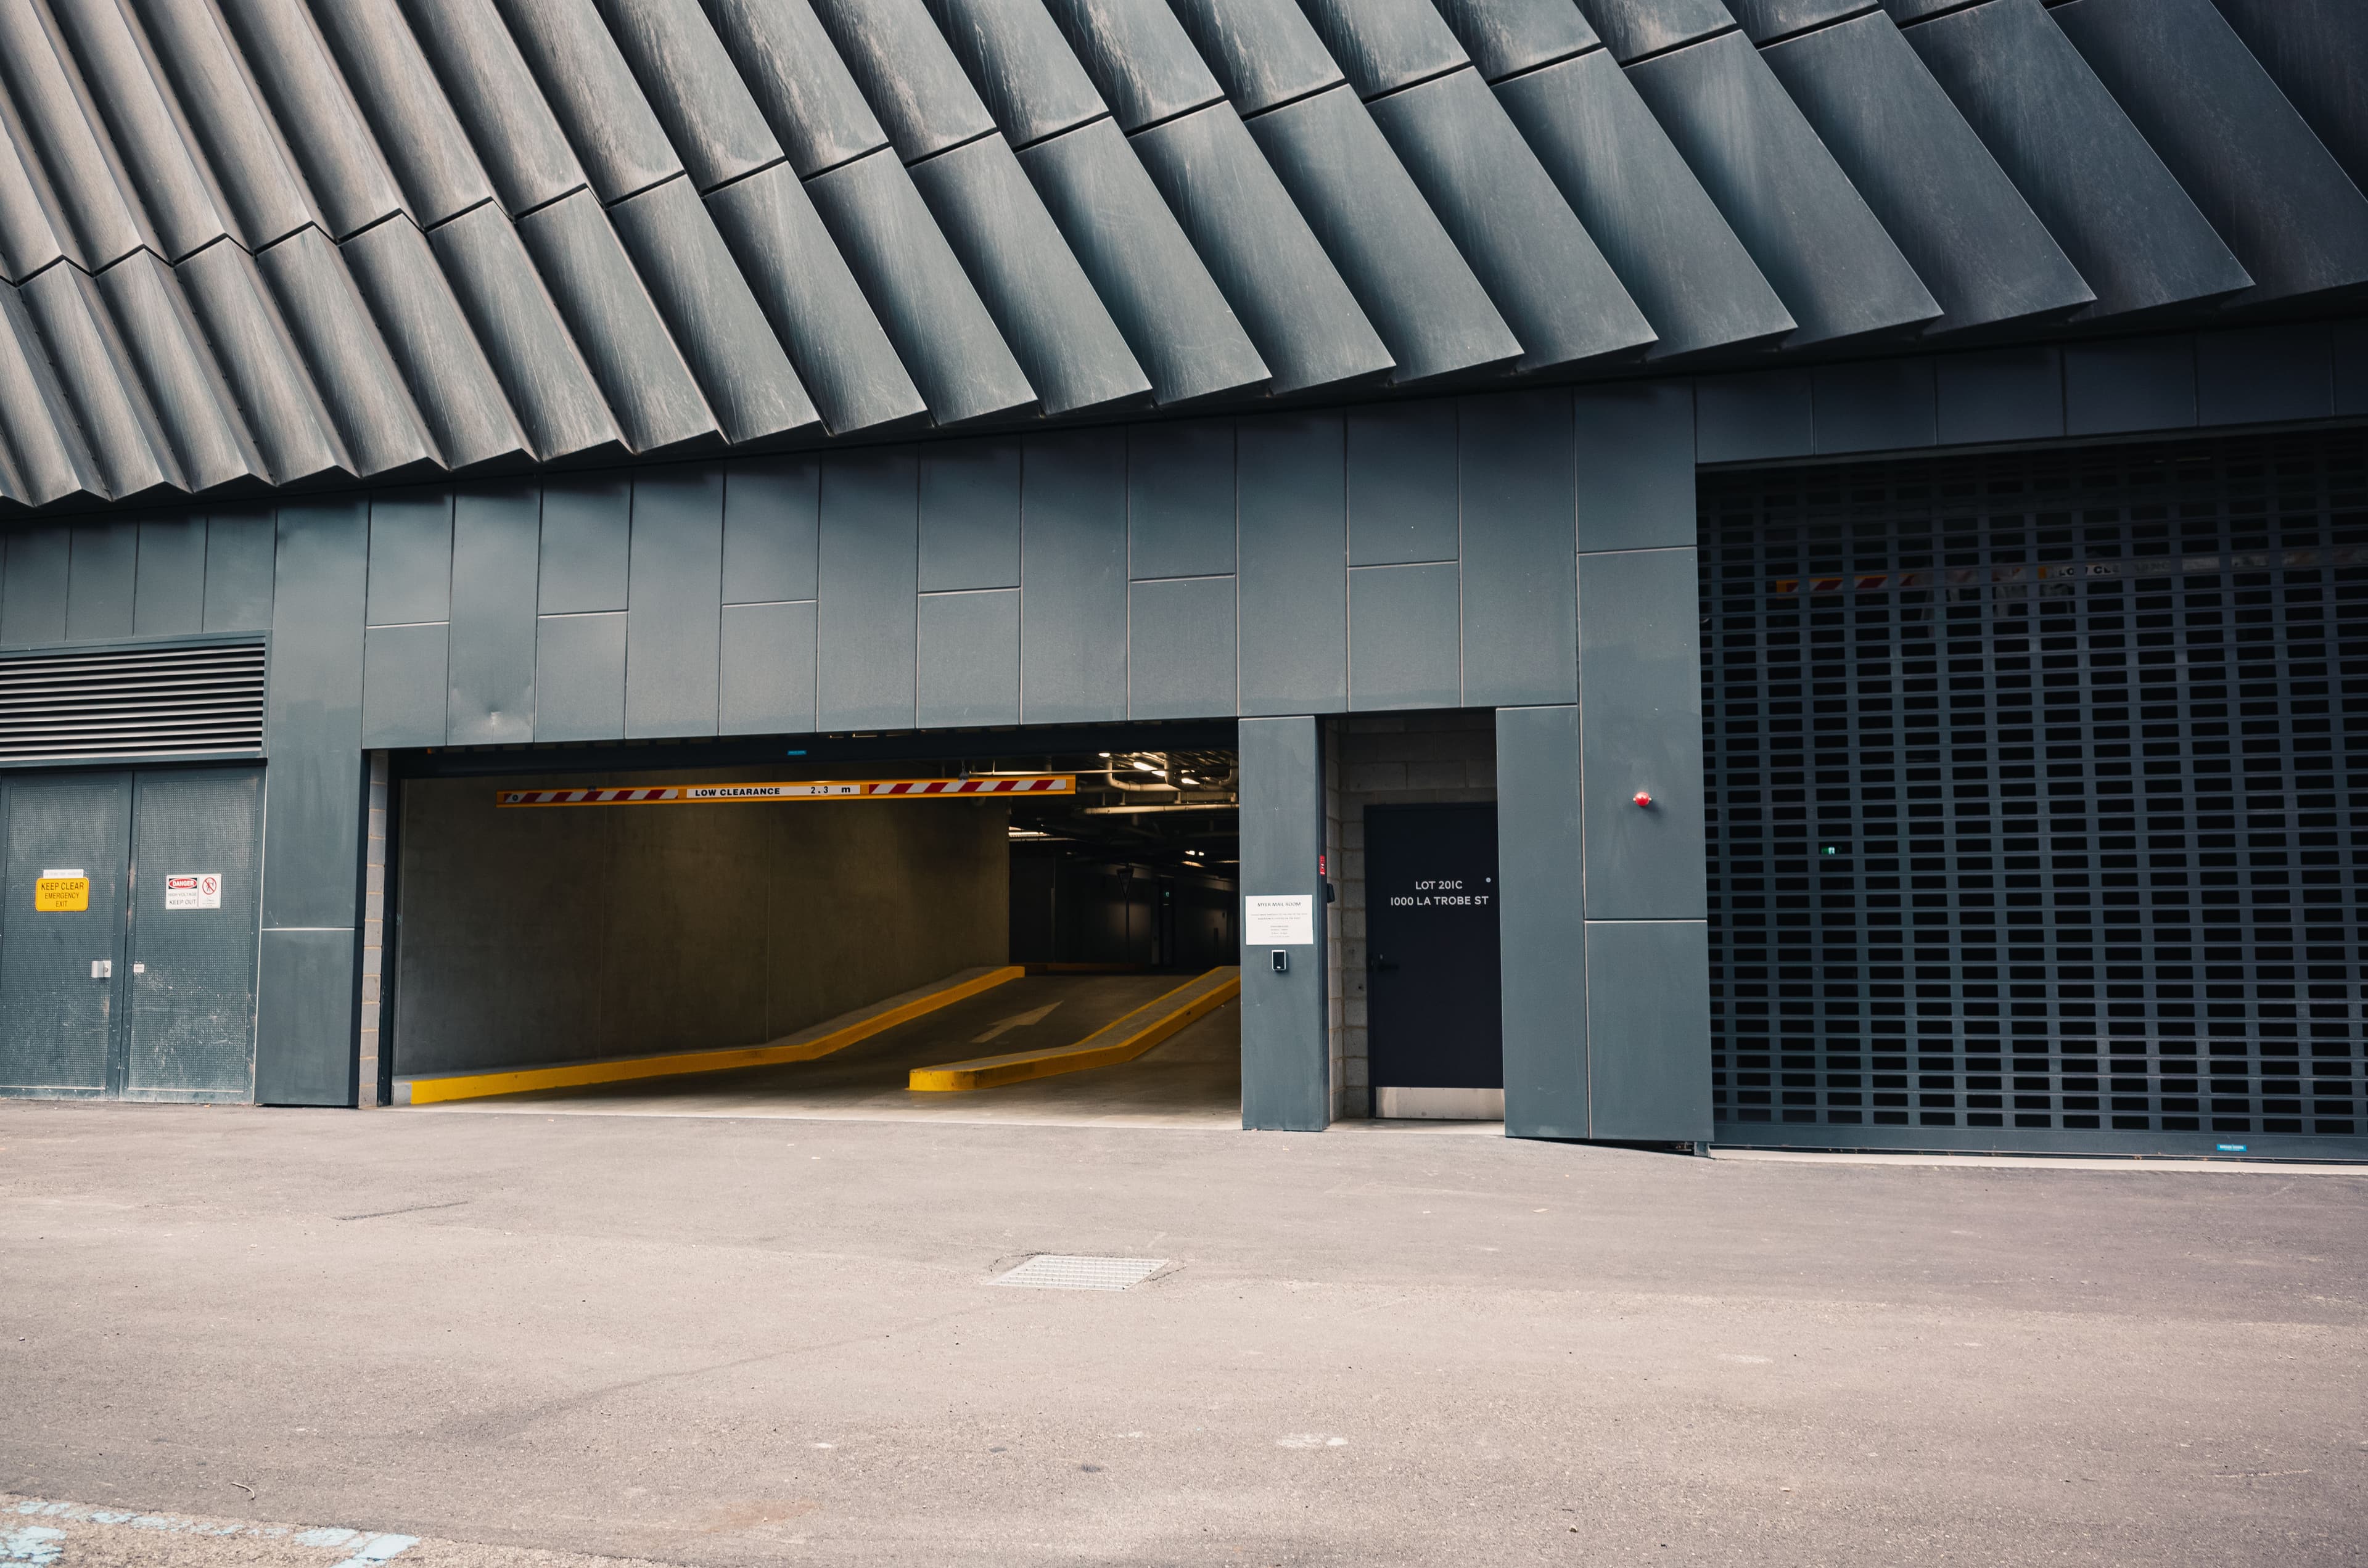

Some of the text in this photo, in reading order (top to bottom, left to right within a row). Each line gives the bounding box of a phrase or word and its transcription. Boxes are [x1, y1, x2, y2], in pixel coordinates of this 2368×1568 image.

[720, 787, 780, 796] CLEARANCE
[810, 786, 829, 794] 2.3
[41, 882, 84, 890] KEEP CLEAR
[1415, 880, 1463, 890] LOT 201C
[1391, 895, 1489, 906] 1000 LA TROBE ST
